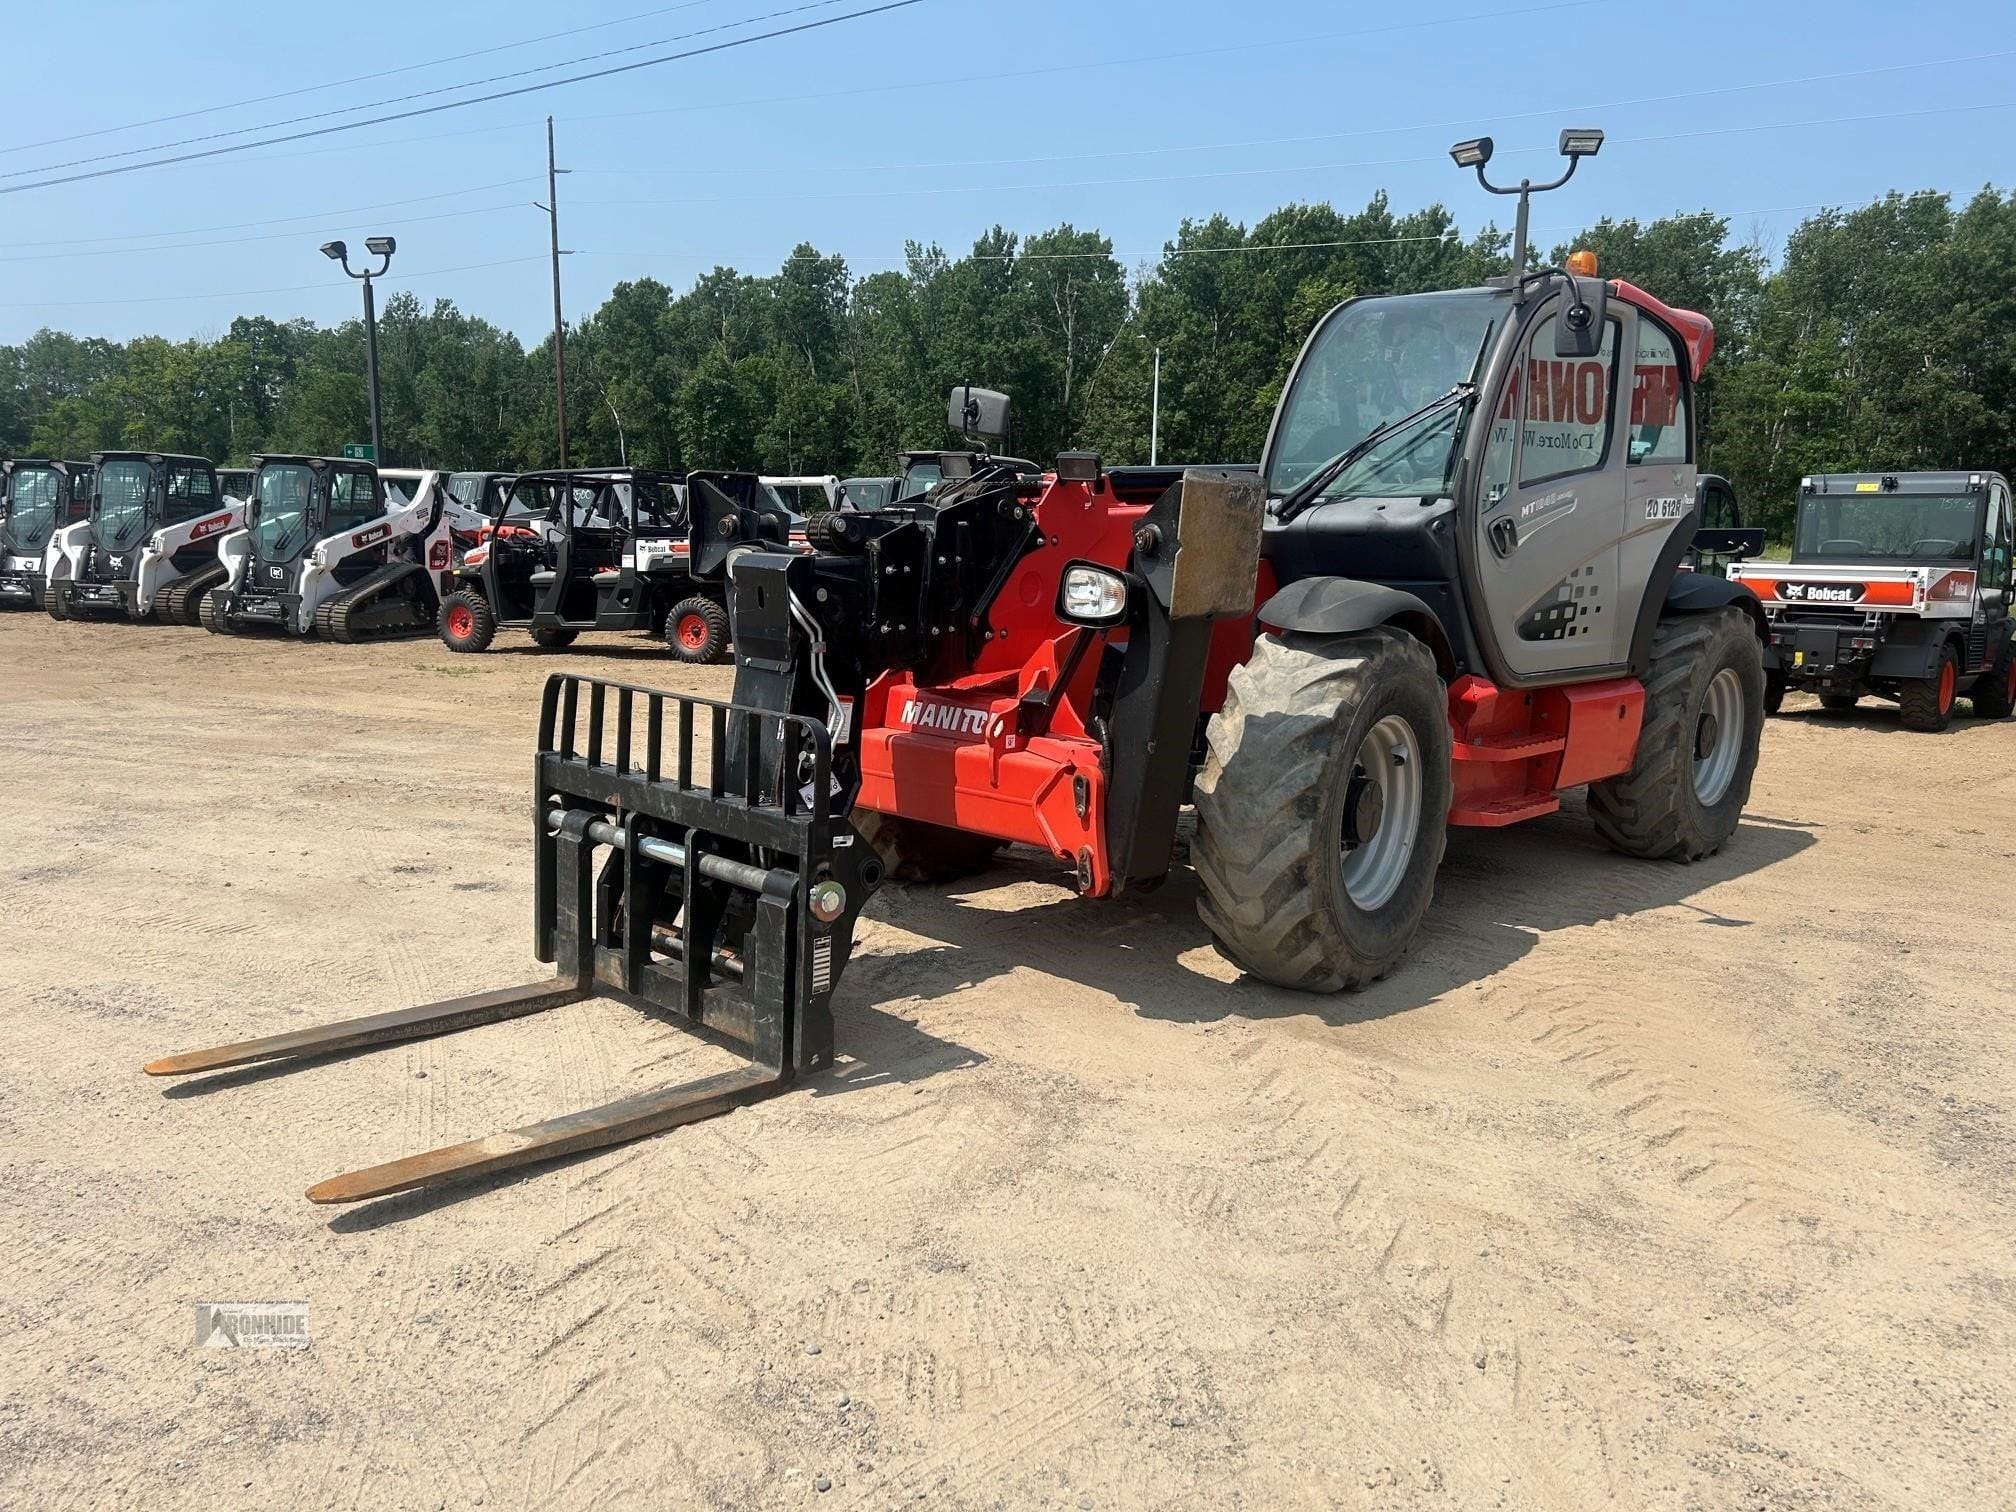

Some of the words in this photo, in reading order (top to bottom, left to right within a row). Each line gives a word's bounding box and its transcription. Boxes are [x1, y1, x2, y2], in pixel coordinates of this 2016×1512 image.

[1647, 499, 1659, 518] 20
[1807, 586, 1852, 601] Bobcat
[900, 700, 996, 735] MANITO
